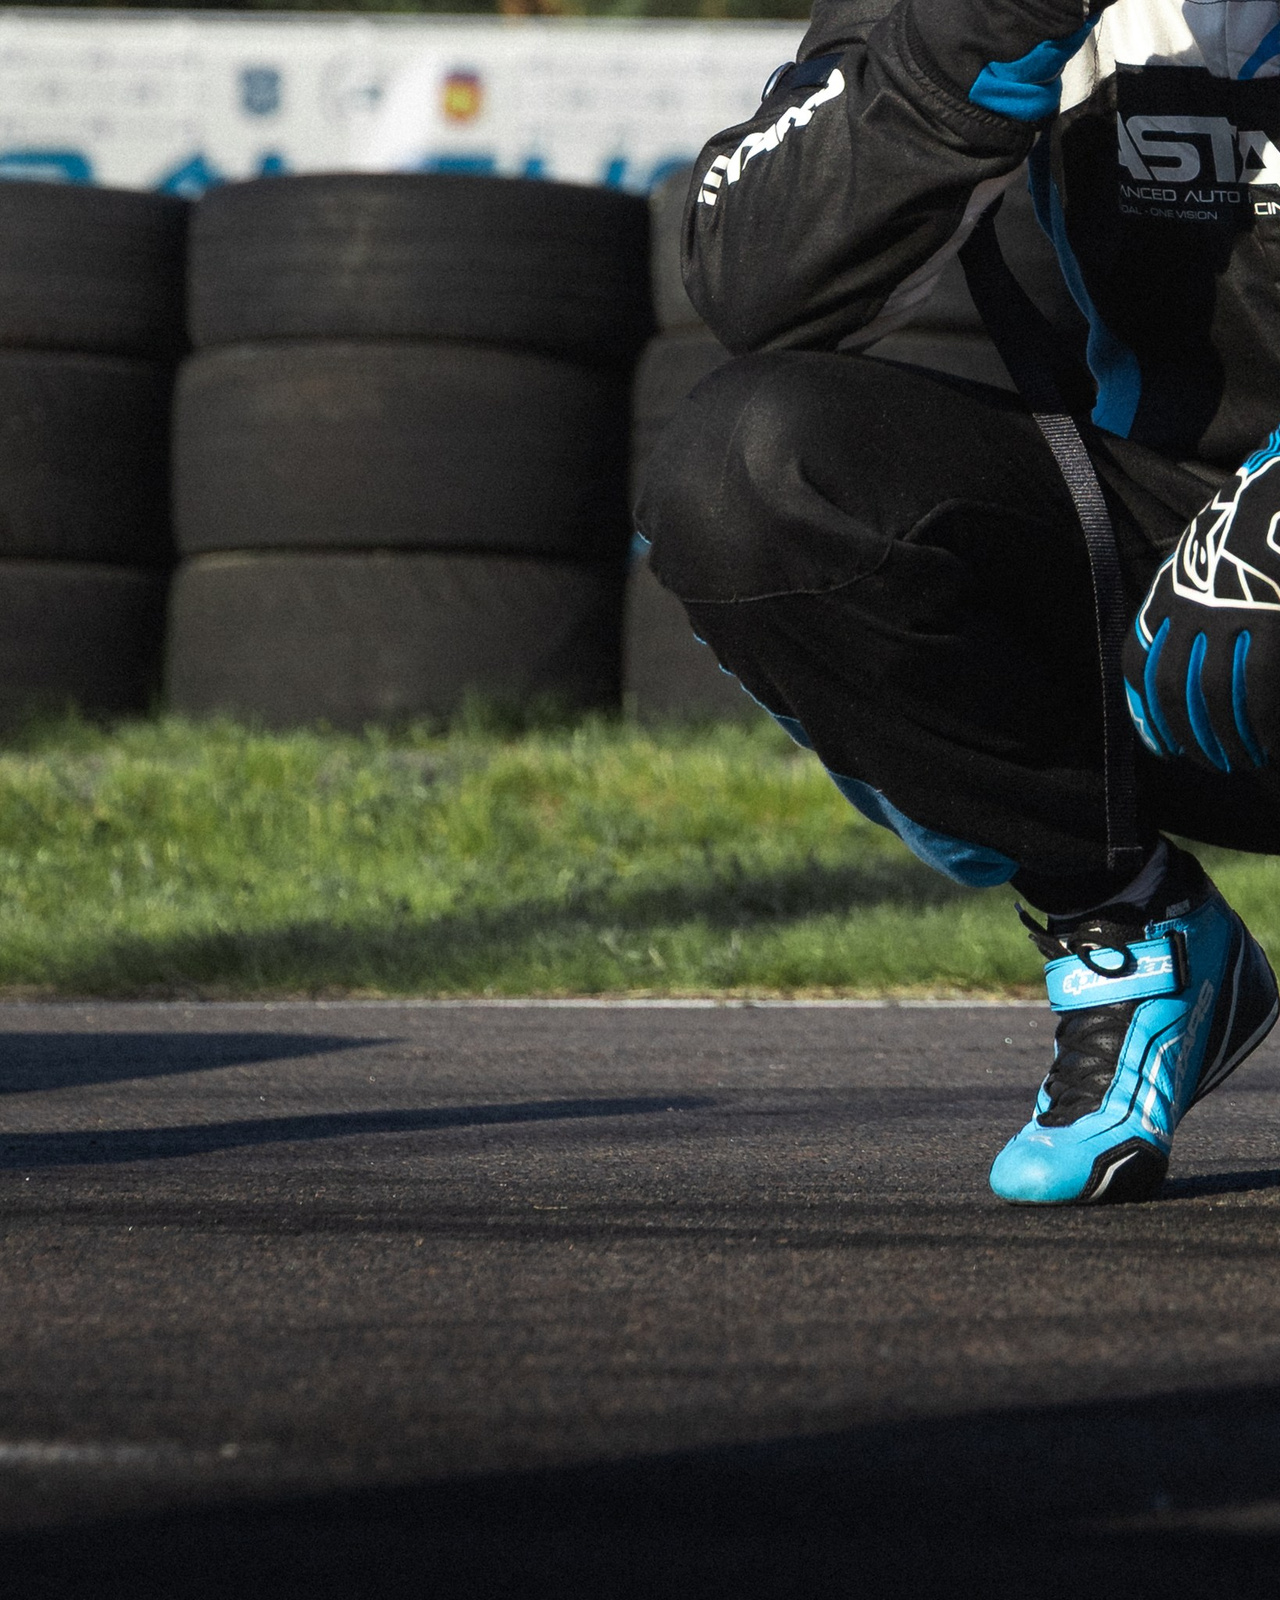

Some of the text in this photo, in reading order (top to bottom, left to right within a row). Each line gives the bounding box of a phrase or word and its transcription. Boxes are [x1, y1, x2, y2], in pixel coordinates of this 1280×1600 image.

[1184, 189, 1240, 204] AUTO
[1150, 208, 1174, 219] ONE
[1175, 209, 1218, 221] VISION
